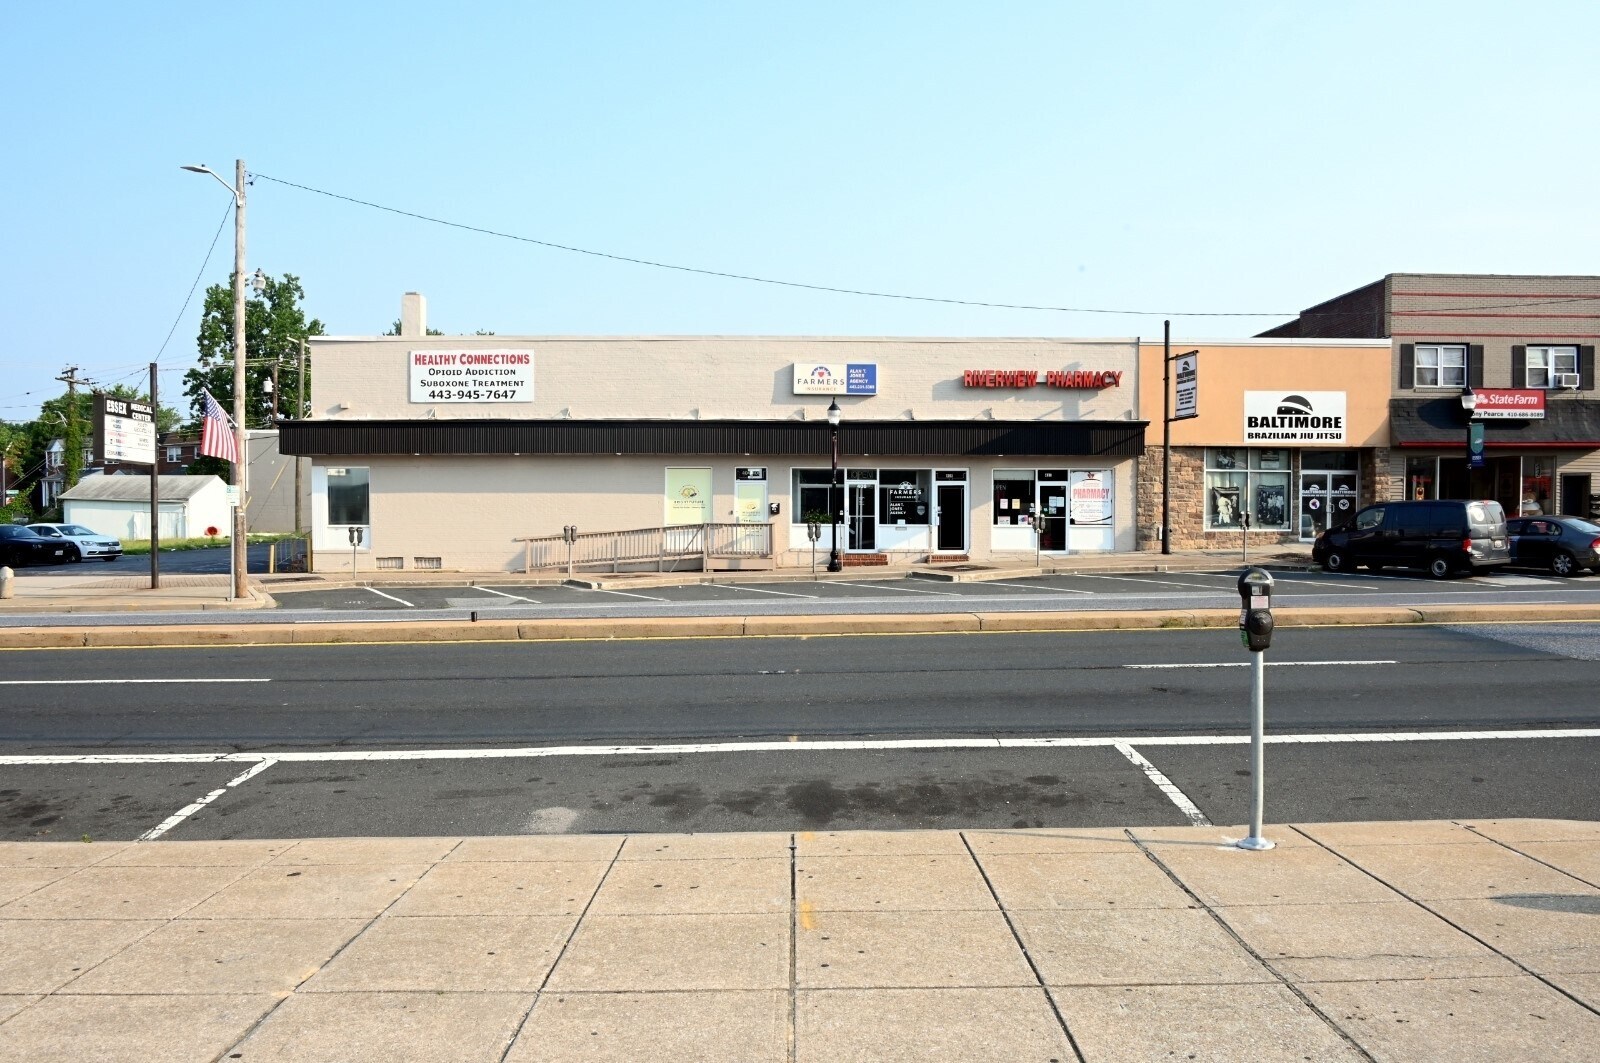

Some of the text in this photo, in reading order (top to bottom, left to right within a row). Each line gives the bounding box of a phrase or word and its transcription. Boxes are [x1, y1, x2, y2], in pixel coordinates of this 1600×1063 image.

[415, 353, 530, 365] HEALTHY CONNECTIONS
[963, 370, 1123, 388] RIVERVIEW PHARMACY
[428, 390, 516, 400] 443-945-7647
[106, 400, 127, 415] ESSEX
[130, 403, 153, 413] MEDICAL
[131, 412, 152, 422] CENTER
[1248, 416, 1342, 428] BALTIMORE
[1073, 488, 1110, 500] PHARMACY
